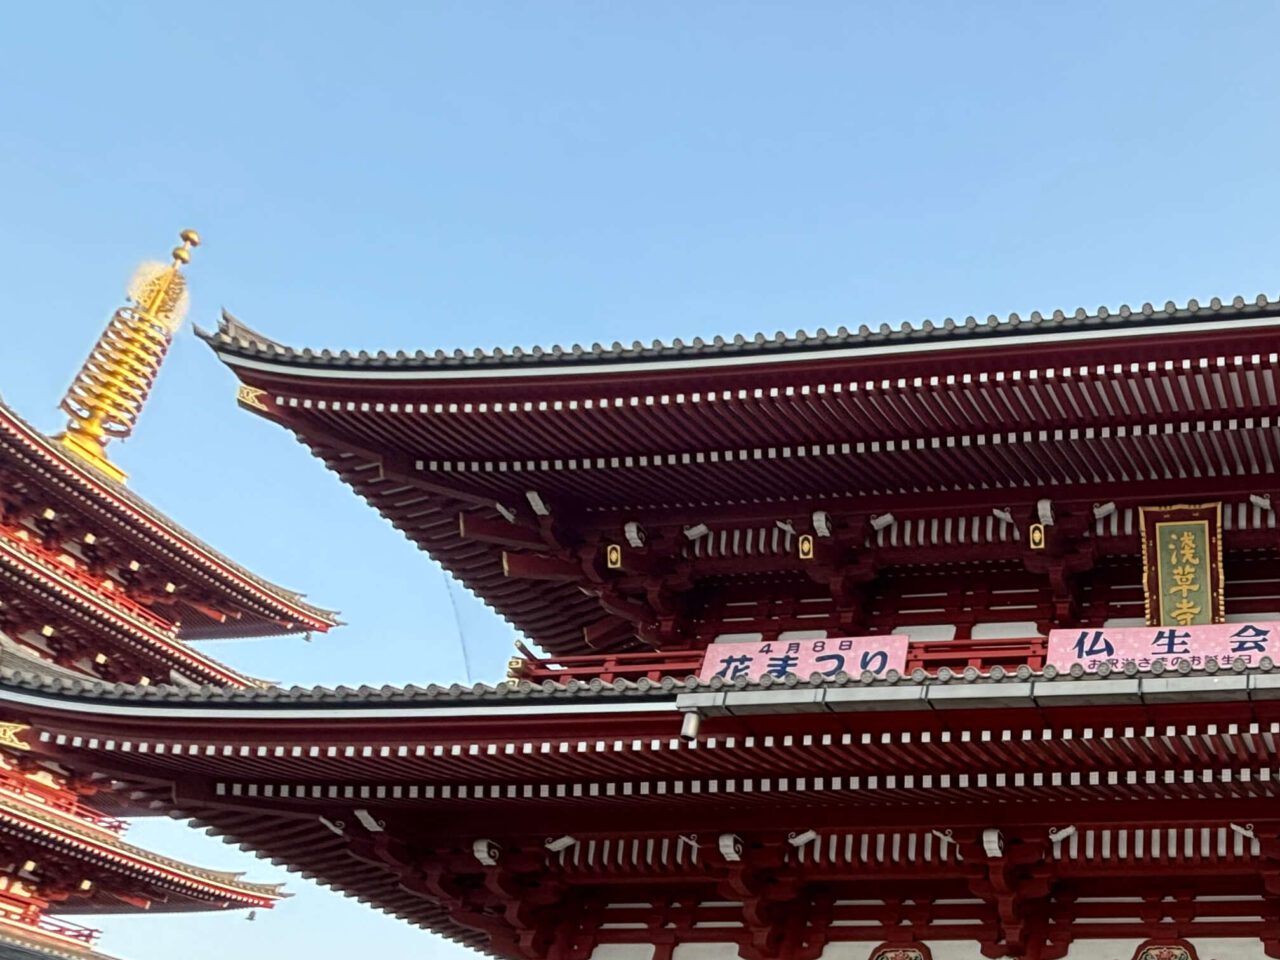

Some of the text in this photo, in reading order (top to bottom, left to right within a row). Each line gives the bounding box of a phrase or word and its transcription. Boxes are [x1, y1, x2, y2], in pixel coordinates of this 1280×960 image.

[759, 640, 853, 655] 4月8日
[1072, 624, 1270, 658] 仏生会
[715, 650, 888, 680] 花まつり
